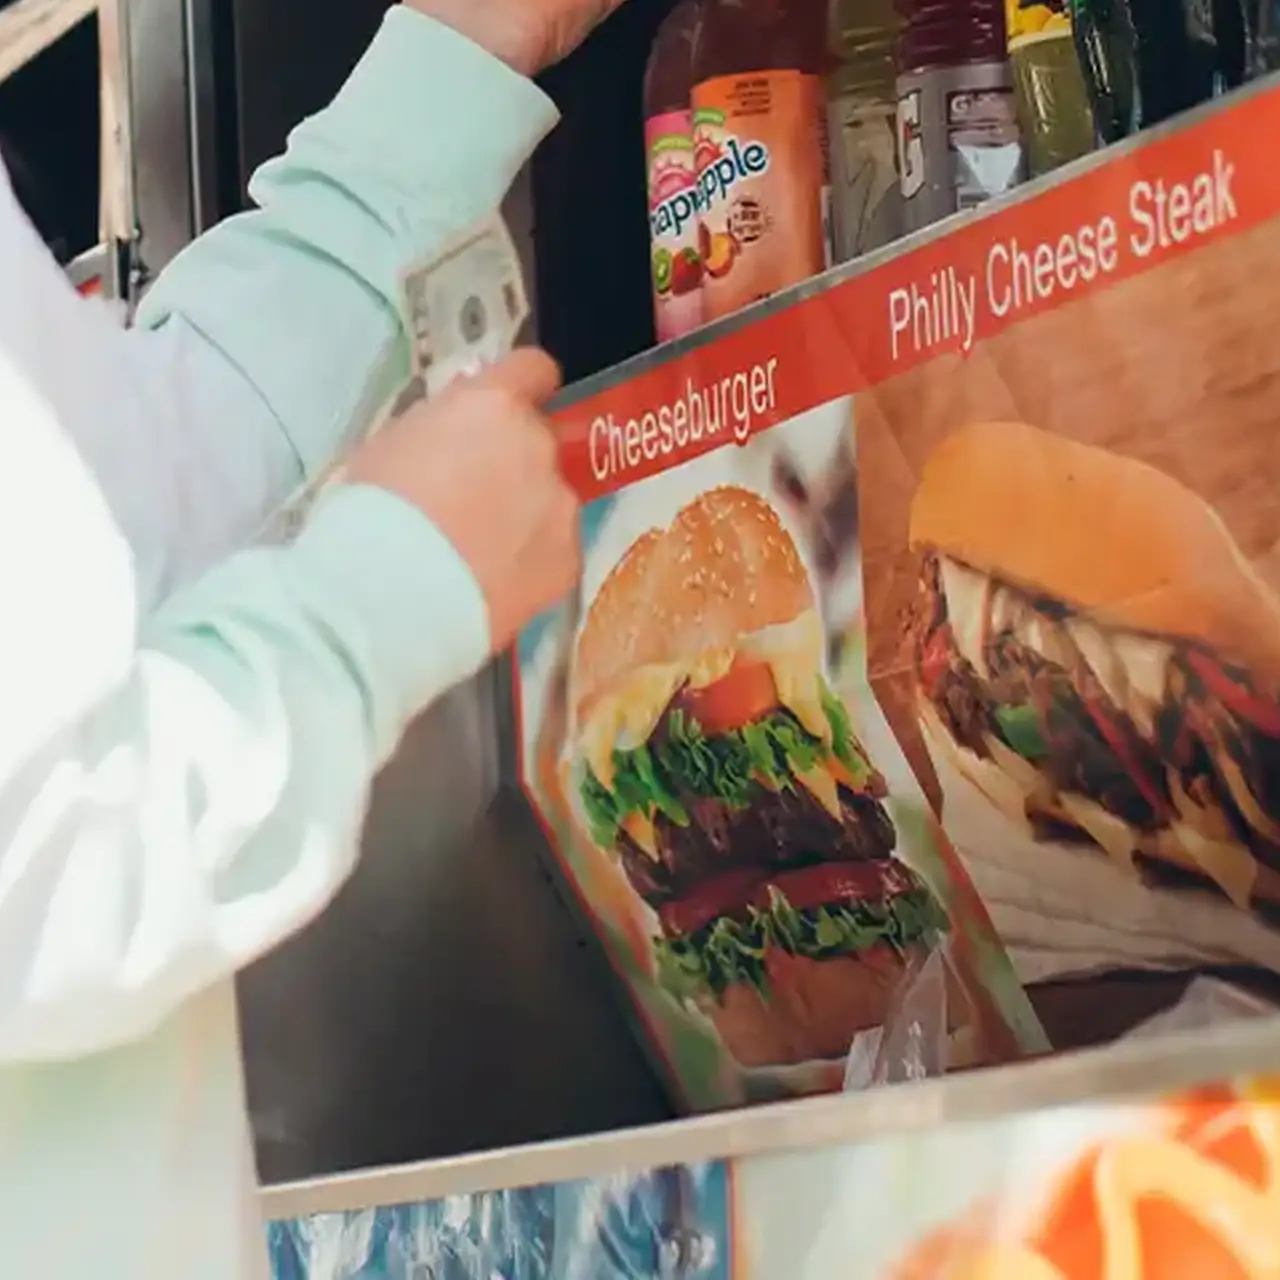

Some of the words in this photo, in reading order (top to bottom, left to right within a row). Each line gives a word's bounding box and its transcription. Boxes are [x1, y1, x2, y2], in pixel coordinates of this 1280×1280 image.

[888, 265, 976, 360] Philly
[985, 215, 1118, 318] Cheese
[1129, 148, 1238, 258] Steak
[588, 357, 778, 481] Cheeseburger
